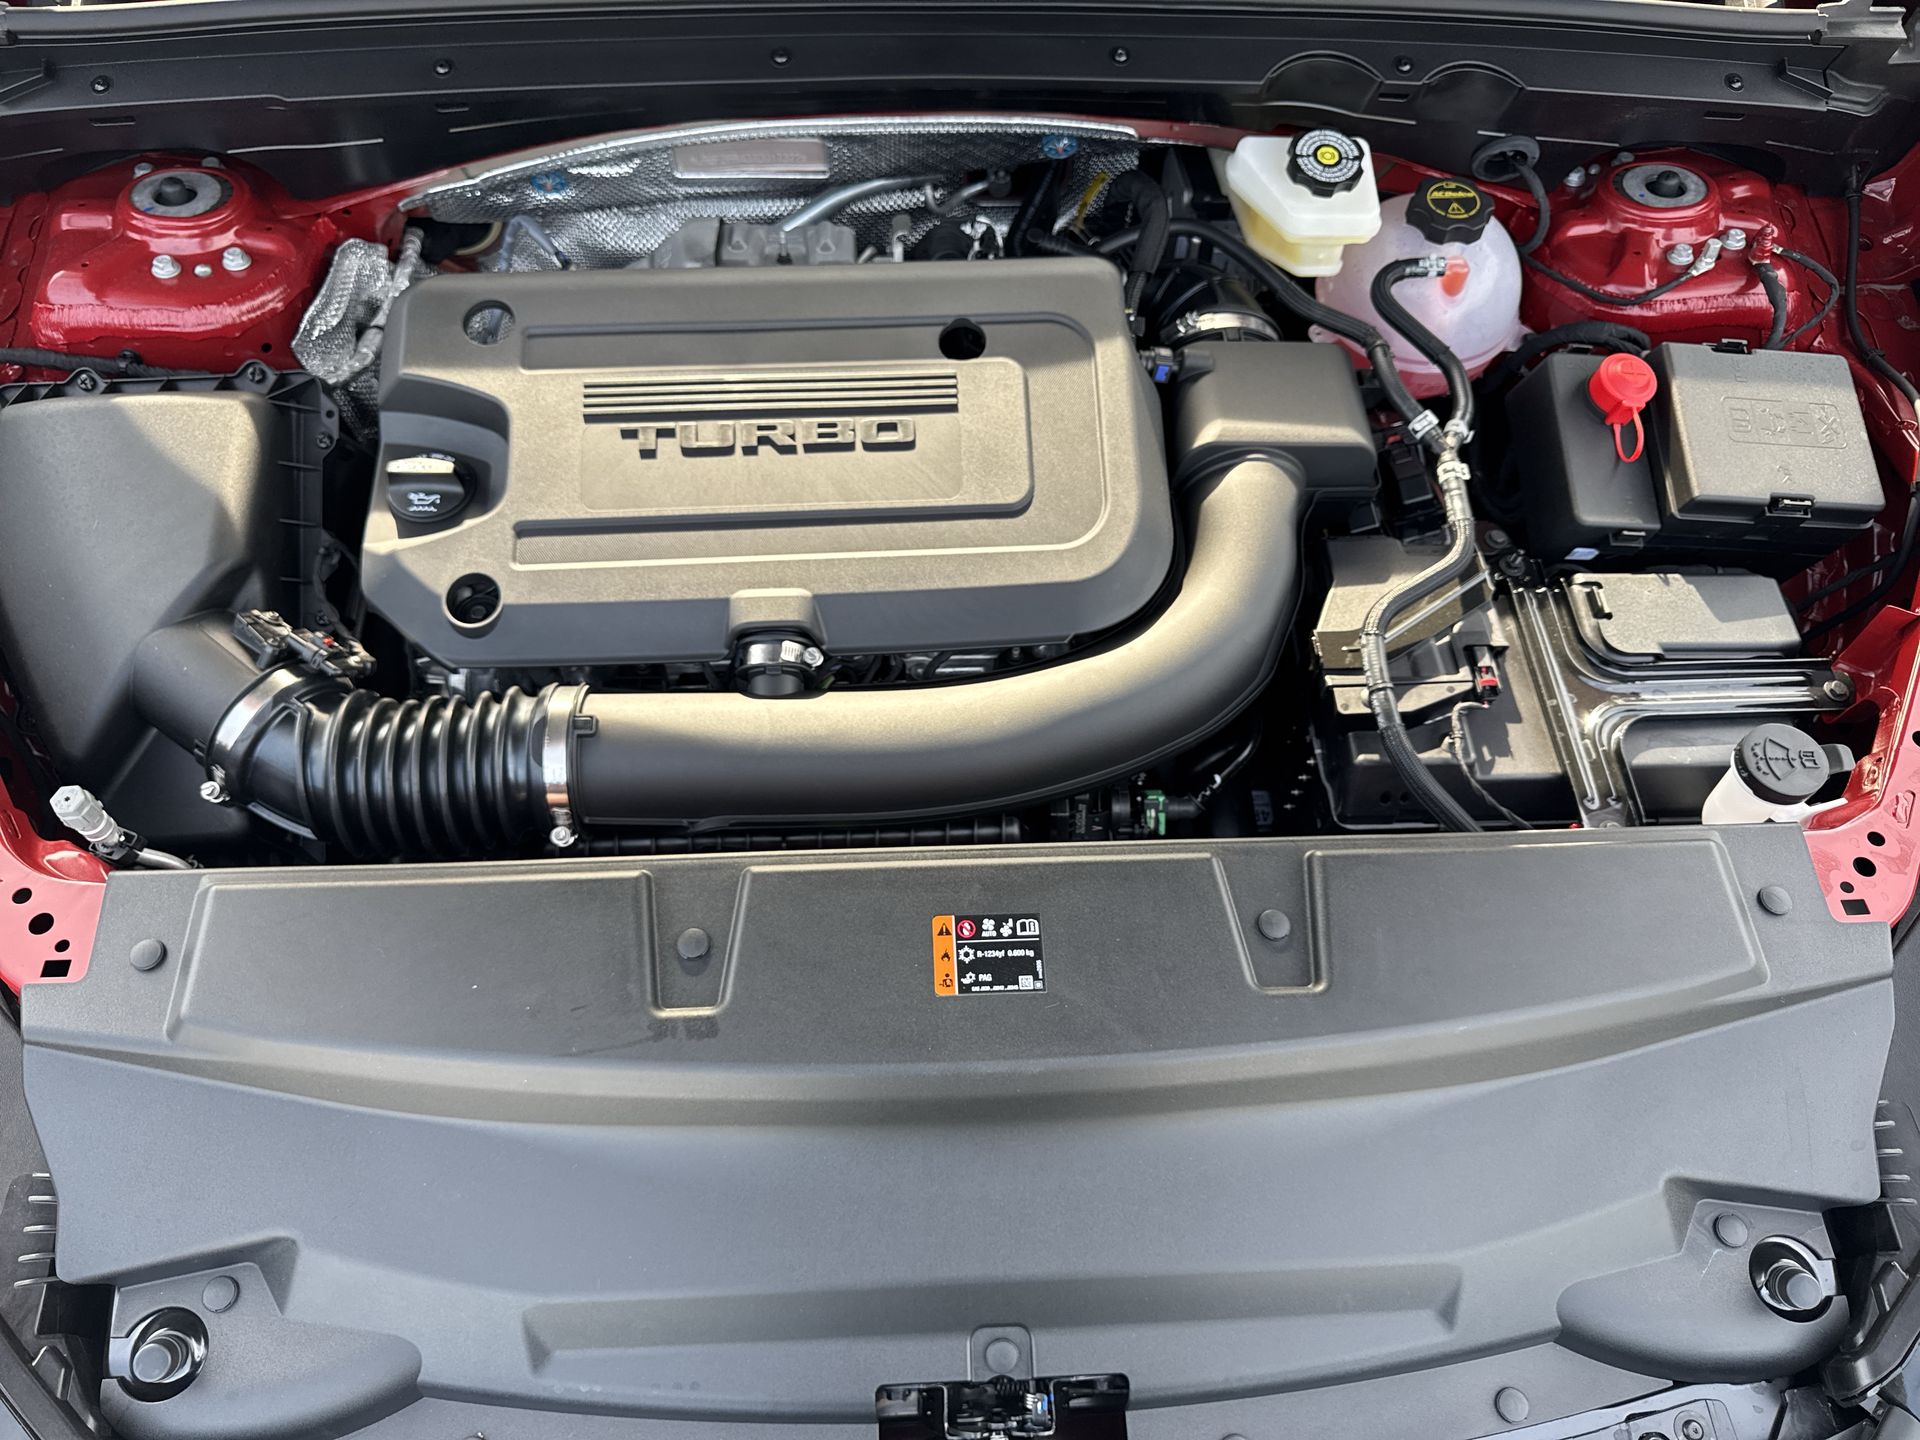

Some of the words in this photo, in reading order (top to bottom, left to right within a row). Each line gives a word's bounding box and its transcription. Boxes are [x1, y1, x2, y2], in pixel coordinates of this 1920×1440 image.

[619, 417, 917, 461] TURBO
[976, 949, 1005, 959] R-1234yf
[1025, 948, 1035, 958] kg
[978, 973, 993, 982] PAG
